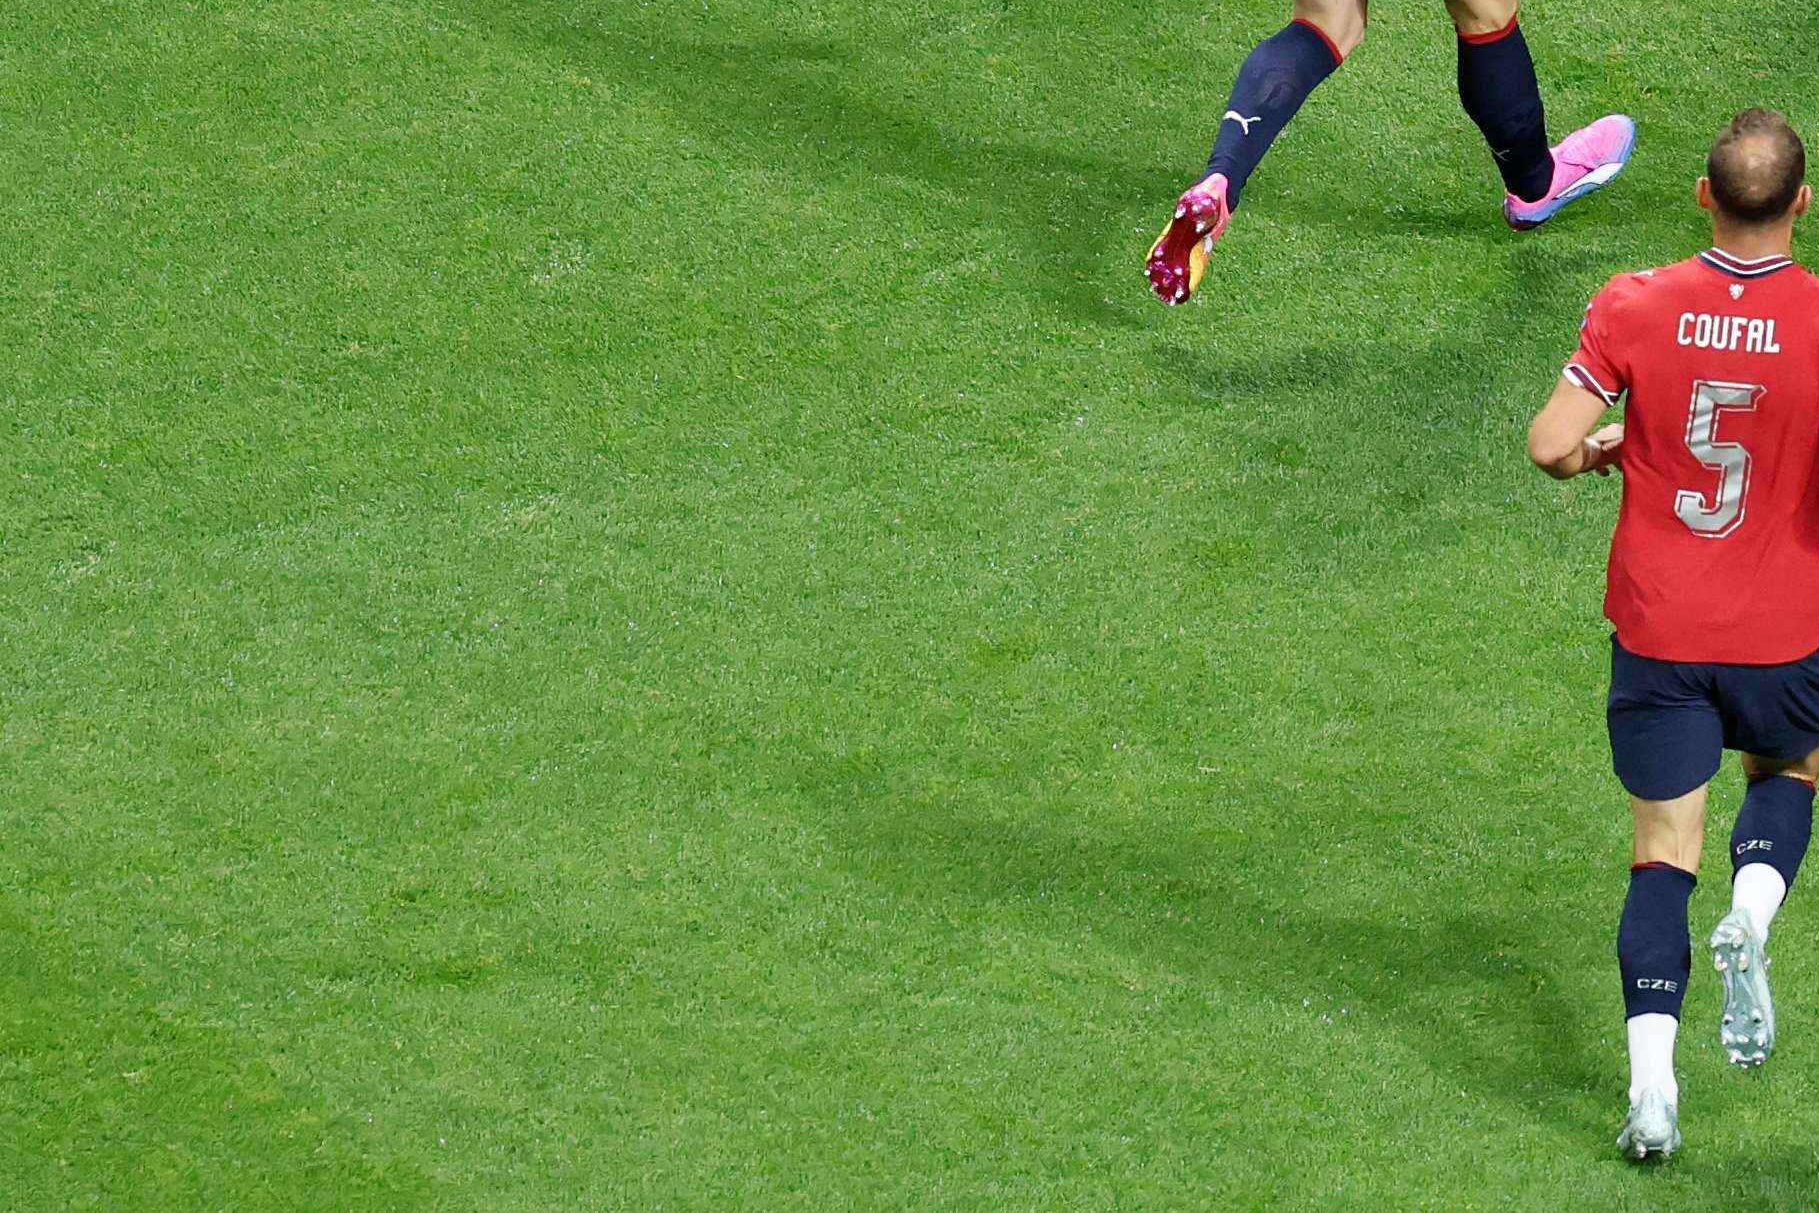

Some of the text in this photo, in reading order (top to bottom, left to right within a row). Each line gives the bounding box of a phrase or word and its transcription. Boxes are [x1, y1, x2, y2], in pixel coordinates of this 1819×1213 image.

[1677, 312, 1780, 353] COUFAL
[1674, 380, 1767, 538] 5
[1736, 840, 1773, 855] CZE
[1637, 978, 1678, 993] CZE
